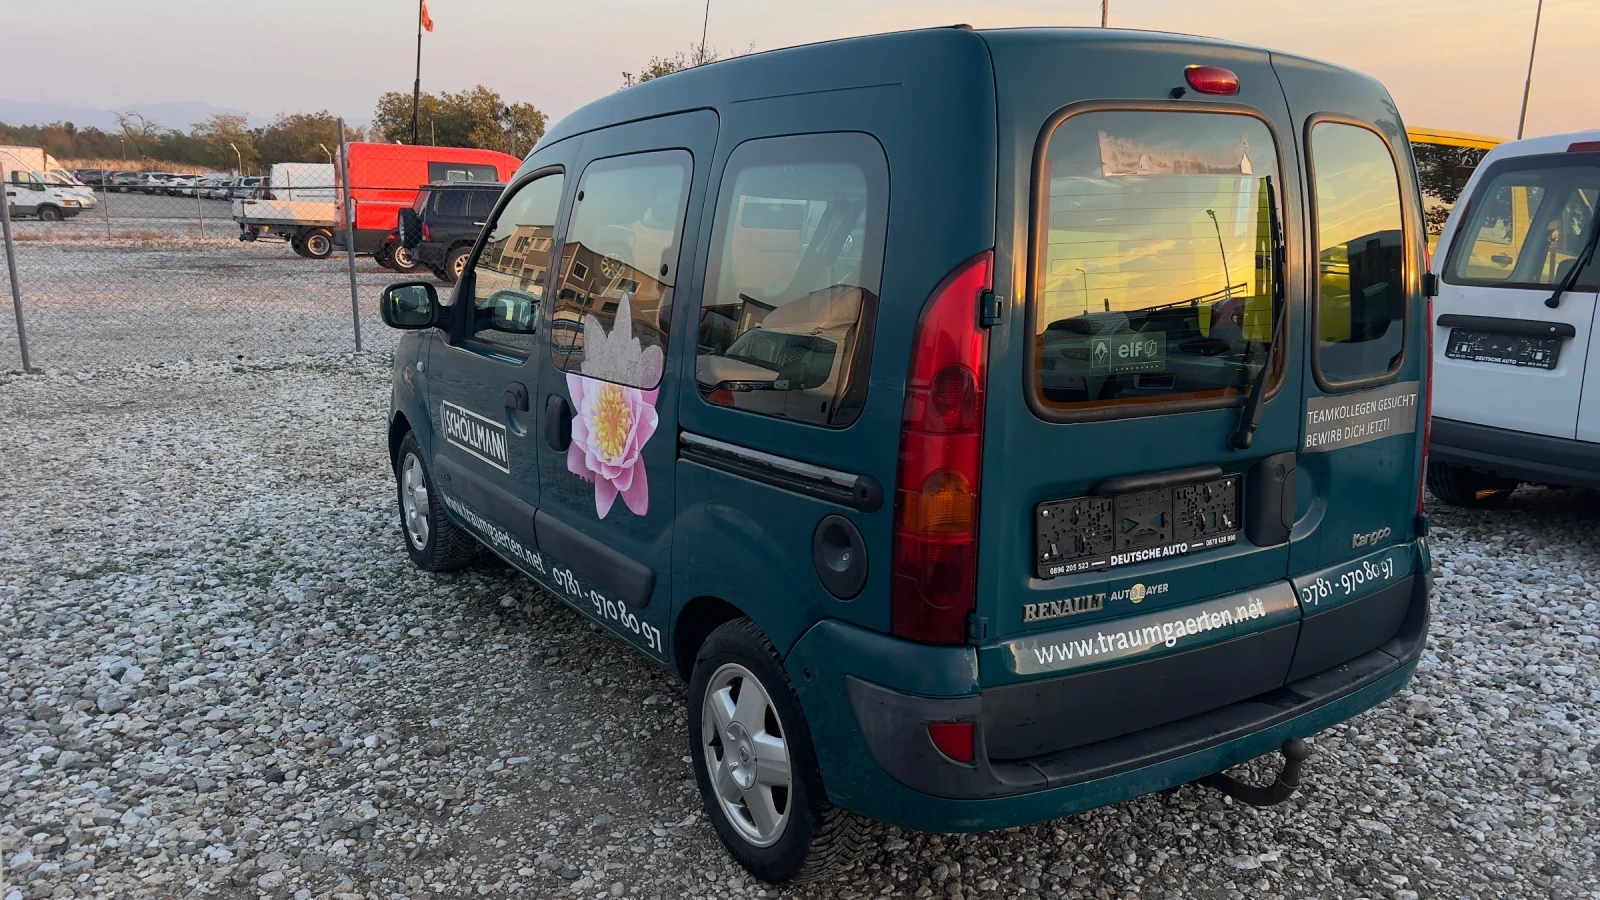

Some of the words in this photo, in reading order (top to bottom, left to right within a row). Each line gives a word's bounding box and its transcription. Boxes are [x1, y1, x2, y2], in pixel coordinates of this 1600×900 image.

[1118, 341, 1143, 358] elf
[1307, 400, 1377, 425] TEAMKOLLEGEN
[1378, 393, 1417, 412] GESUCHT
[445, 409, 507, 463] SCHÖLLMANN
[1306, 428, 1342, 448] BEWIRB
[1344, 423, 1365, 440] DICH
[1366, 417, 1390, 435] JETZT!
[1351, 526, 1392, 549] Kangoo
[1110, 547, 1161, 566] DEUTSCHE
[1162, 542, 1188, 557] AUTO
[443, 493, 547, 575] www.traumgaerten.net
[552, 567, 583, 598] 0781
[641, 621, 662, 654] 97
[1302, 577, 1333, 606] 0781
[1381, 557, 1393, 580] 97
[1023, 592, 1107, 624] RENAULT
[1034, 597, 1268, 665] www.traumgaerten.net
